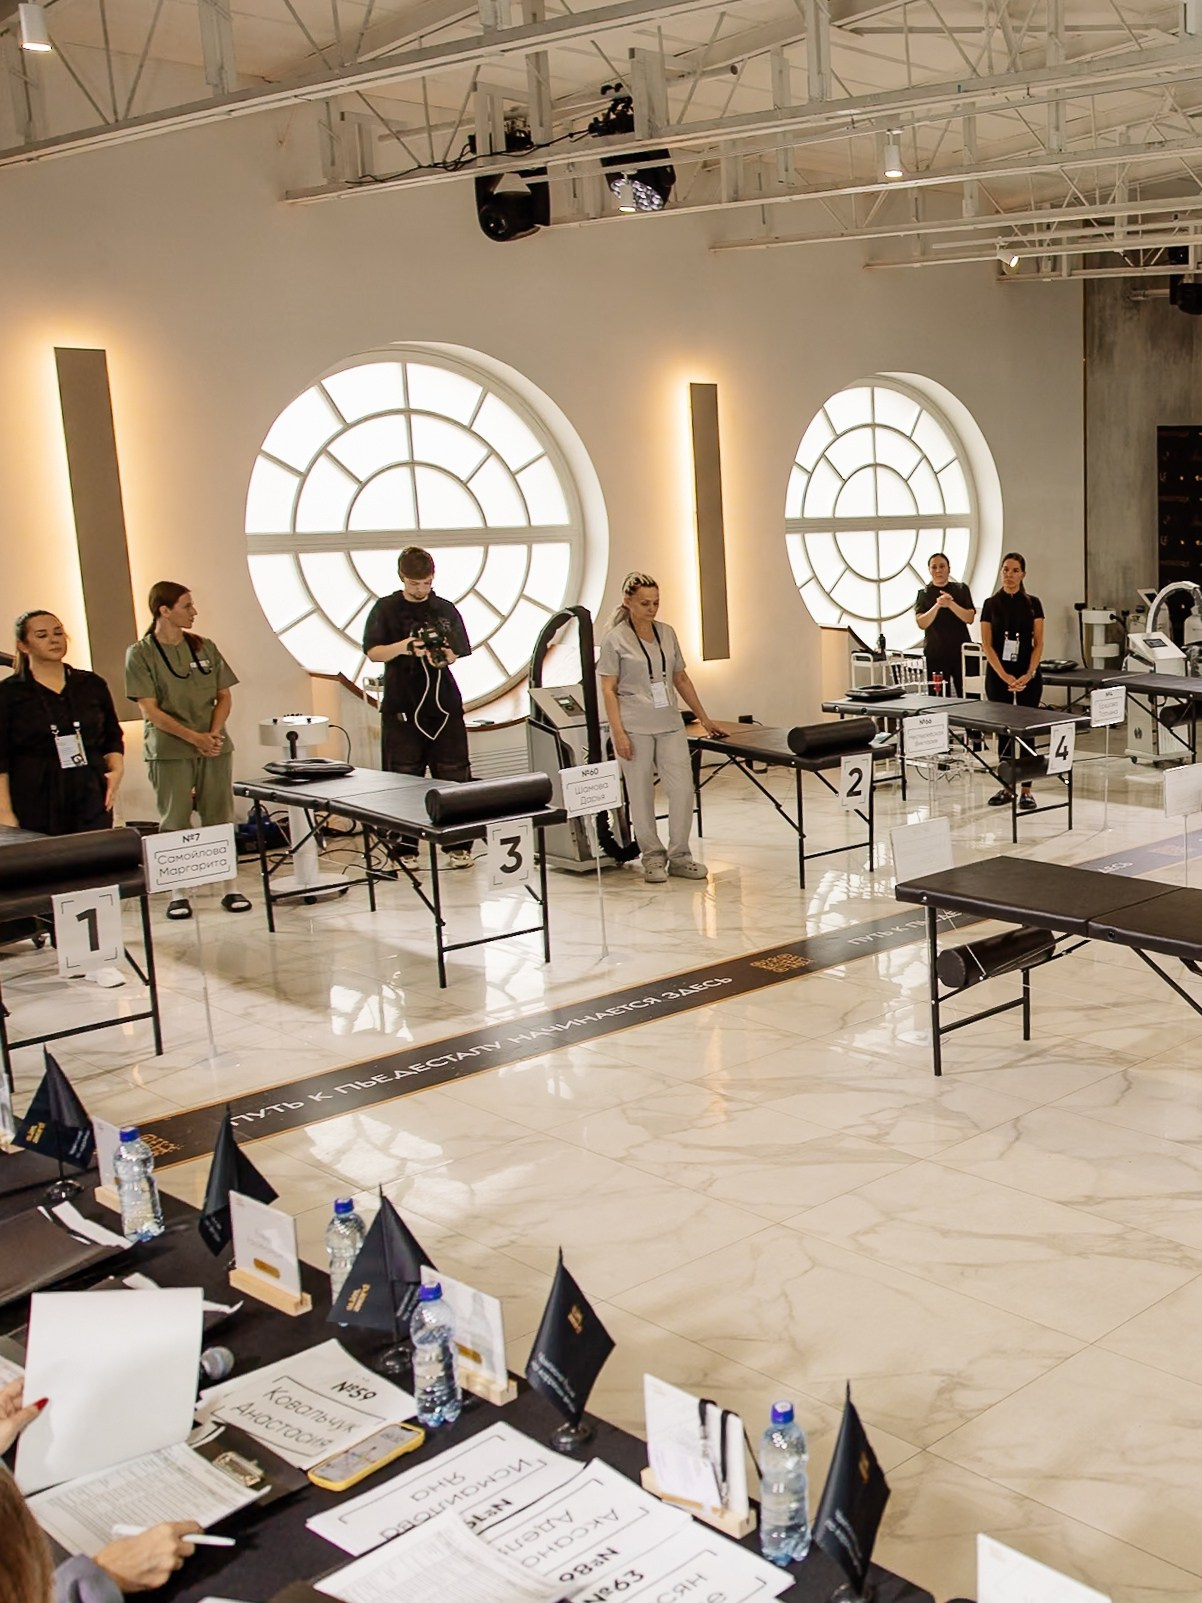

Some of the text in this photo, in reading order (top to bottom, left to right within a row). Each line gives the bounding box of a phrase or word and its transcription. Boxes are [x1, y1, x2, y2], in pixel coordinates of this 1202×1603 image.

[1053, 735, 1070, 761] 4
[582, 767, 599, 777] №60
[846, 767, 862, 797] 2
[575, 782, 609, 795] Шамова
[182, 832, 201, 844] №7
[157, 843, 228, 866] Самойлова
[159, 859, 228, 878] Маргарита
[500, 836, 523, 873] 3
[75, 908, 100, 952] 1
[848, 930, 892, 945] ПУТЬ
[230, 973, 733, 1126] ПУТЬ К ПЬЕДЕСТАЛУ НАЧИНАЕТСЯ ЗДЕСЬ
[331, 1380, 377, 1401] №59
[263, 1385, 362, 1435] Ковальчук
[231, 1401, 334, 1450] Анастасия
[410, 1472, 465, 1501] Яна
[559, 1547, 619, 1582] №86
[584, 1569, 645, 1603] №63
